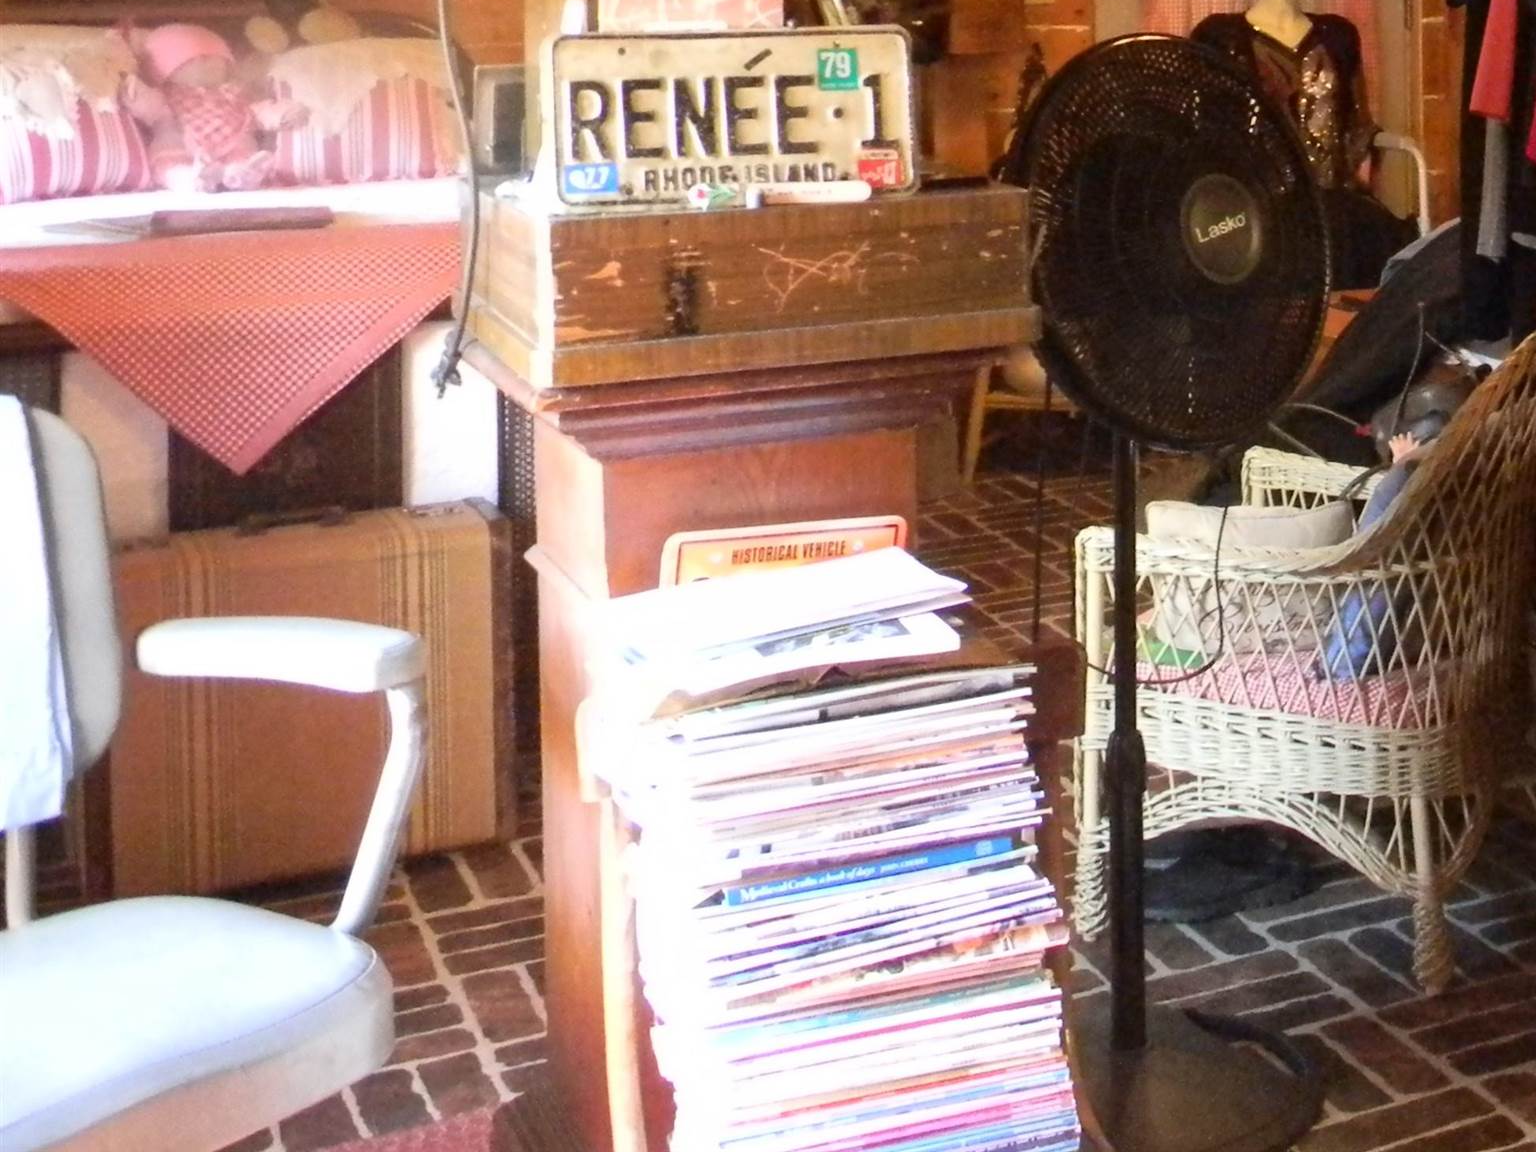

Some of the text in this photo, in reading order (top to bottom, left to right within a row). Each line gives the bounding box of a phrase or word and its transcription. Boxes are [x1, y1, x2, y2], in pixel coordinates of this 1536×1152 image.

[820, 51, 852, 80] 79
[643, 163, 737, 193] RHODE
[744, 160, 836, 187] ISLAND
[1194, 214, 1246, 244] Lasko
[731, 539, 847, 566] HISTORICAL VEHICLE
